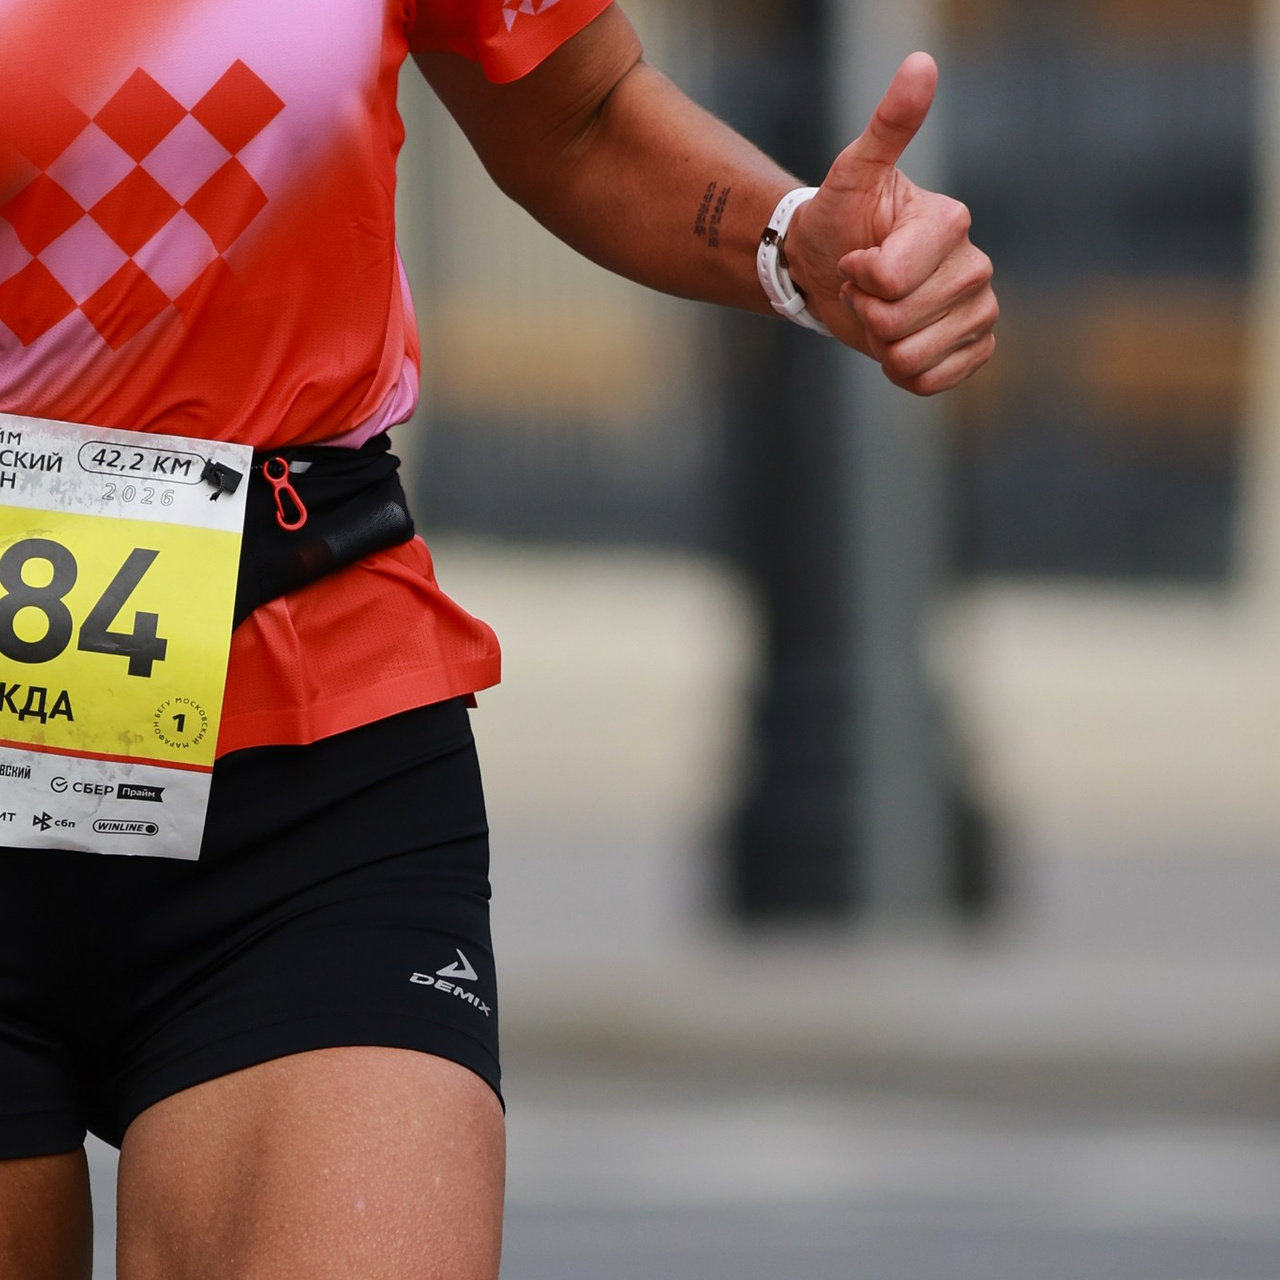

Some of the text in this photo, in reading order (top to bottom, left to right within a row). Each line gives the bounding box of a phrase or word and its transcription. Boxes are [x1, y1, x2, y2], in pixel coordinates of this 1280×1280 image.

[92, 448, 192, 477] 42,2 КМ
[102, 482, 175, 506] 2026
[153, 697, 208, 748] БЕГУ МОСКОВСКИЙ МАРАФОН
[172, 713, 185, 733] 1
[72, 782, 156, 798] СБЕР Прайм
[55, 819, 76, 828] сбп
[98, 822, 145, 832] WINLINE
[409, 972, 491, 1017] DEMIX
